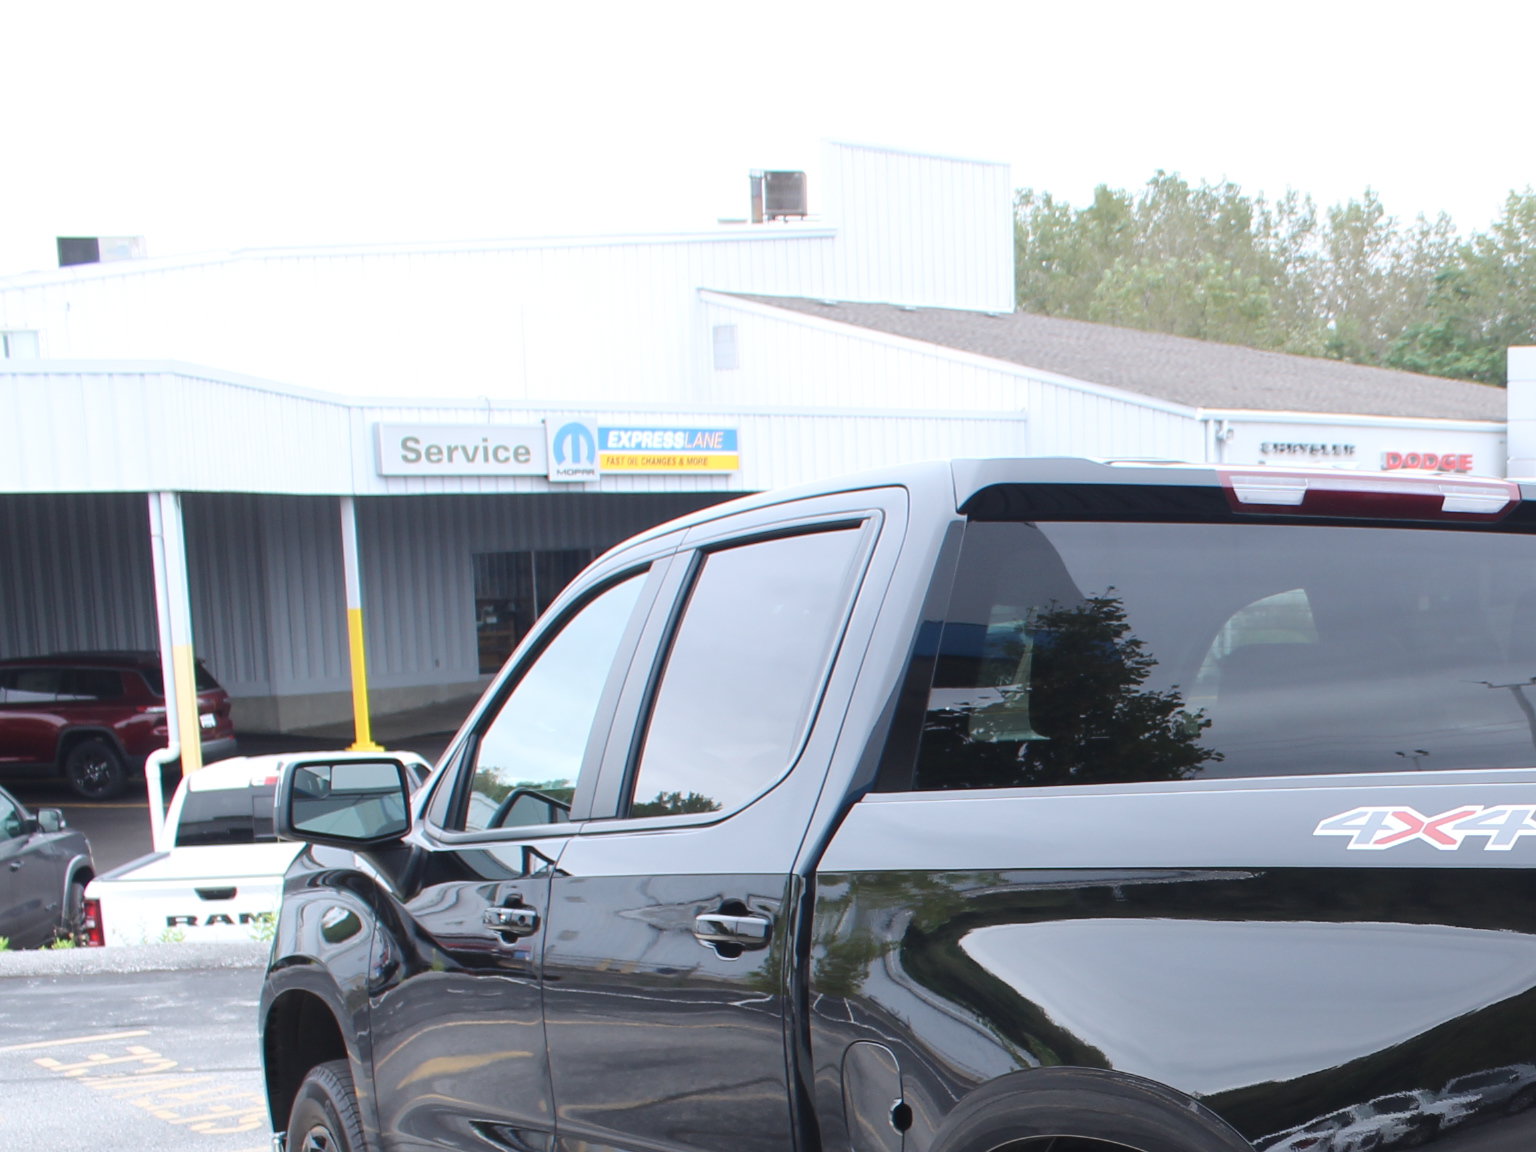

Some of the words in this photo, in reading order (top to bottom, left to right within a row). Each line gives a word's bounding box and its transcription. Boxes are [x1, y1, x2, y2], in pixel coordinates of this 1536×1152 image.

[400, 436, 531, 464] Service
[605, 455, 625, 467] FAST
[627, 456, 639, 467] OIL
[641, 456, 675, 467] CHANGES
[687, 457, 709, 467] MORE
[1382, 452, 1474, 472] DODGE
[557, 468, 596, 477] MOPAR
[166, 911, 272, 928] RAM
